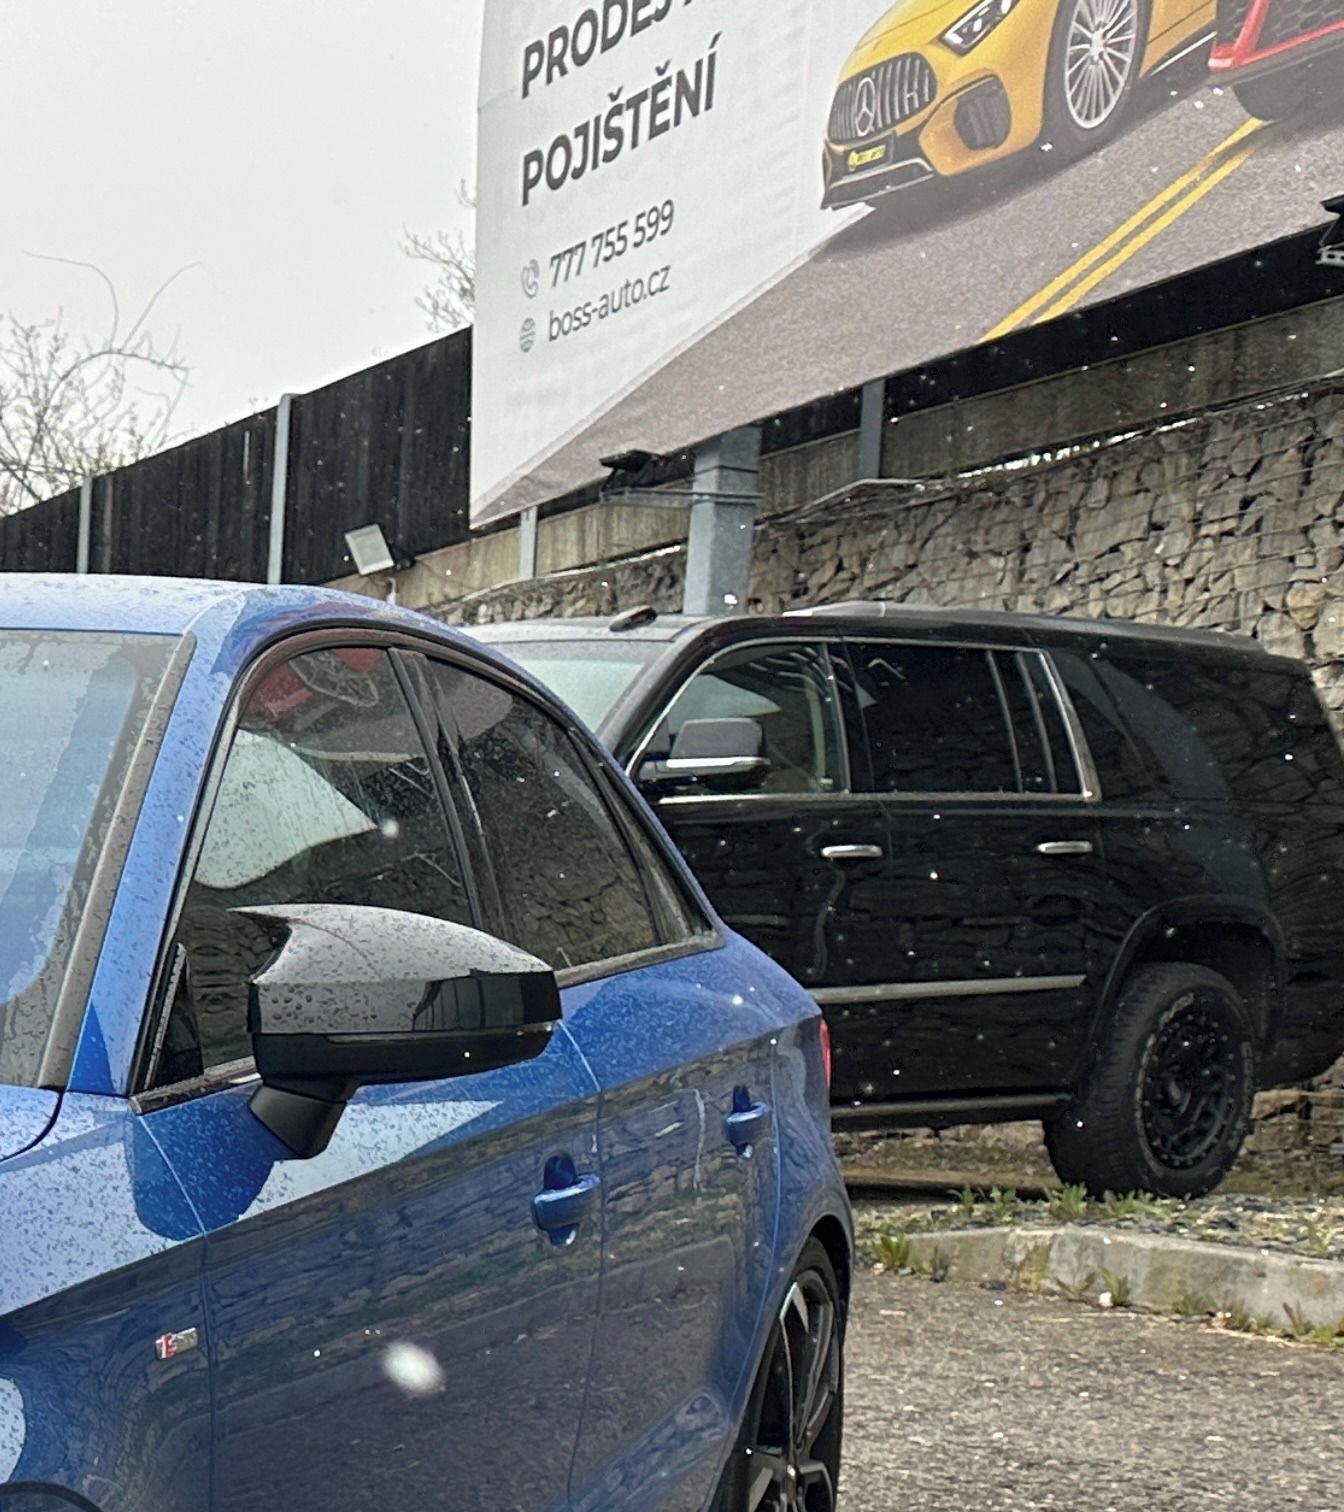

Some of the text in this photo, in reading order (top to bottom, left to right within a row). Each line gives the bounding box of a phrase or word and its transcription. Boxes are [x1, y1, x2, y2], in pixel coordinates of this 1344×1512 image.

[521, 31, 723, 207] POJIŠTĚNÍ
[549, 199, 675, 289] 777 755 599
[548, 265, 671, 342] boss-auto.cz
